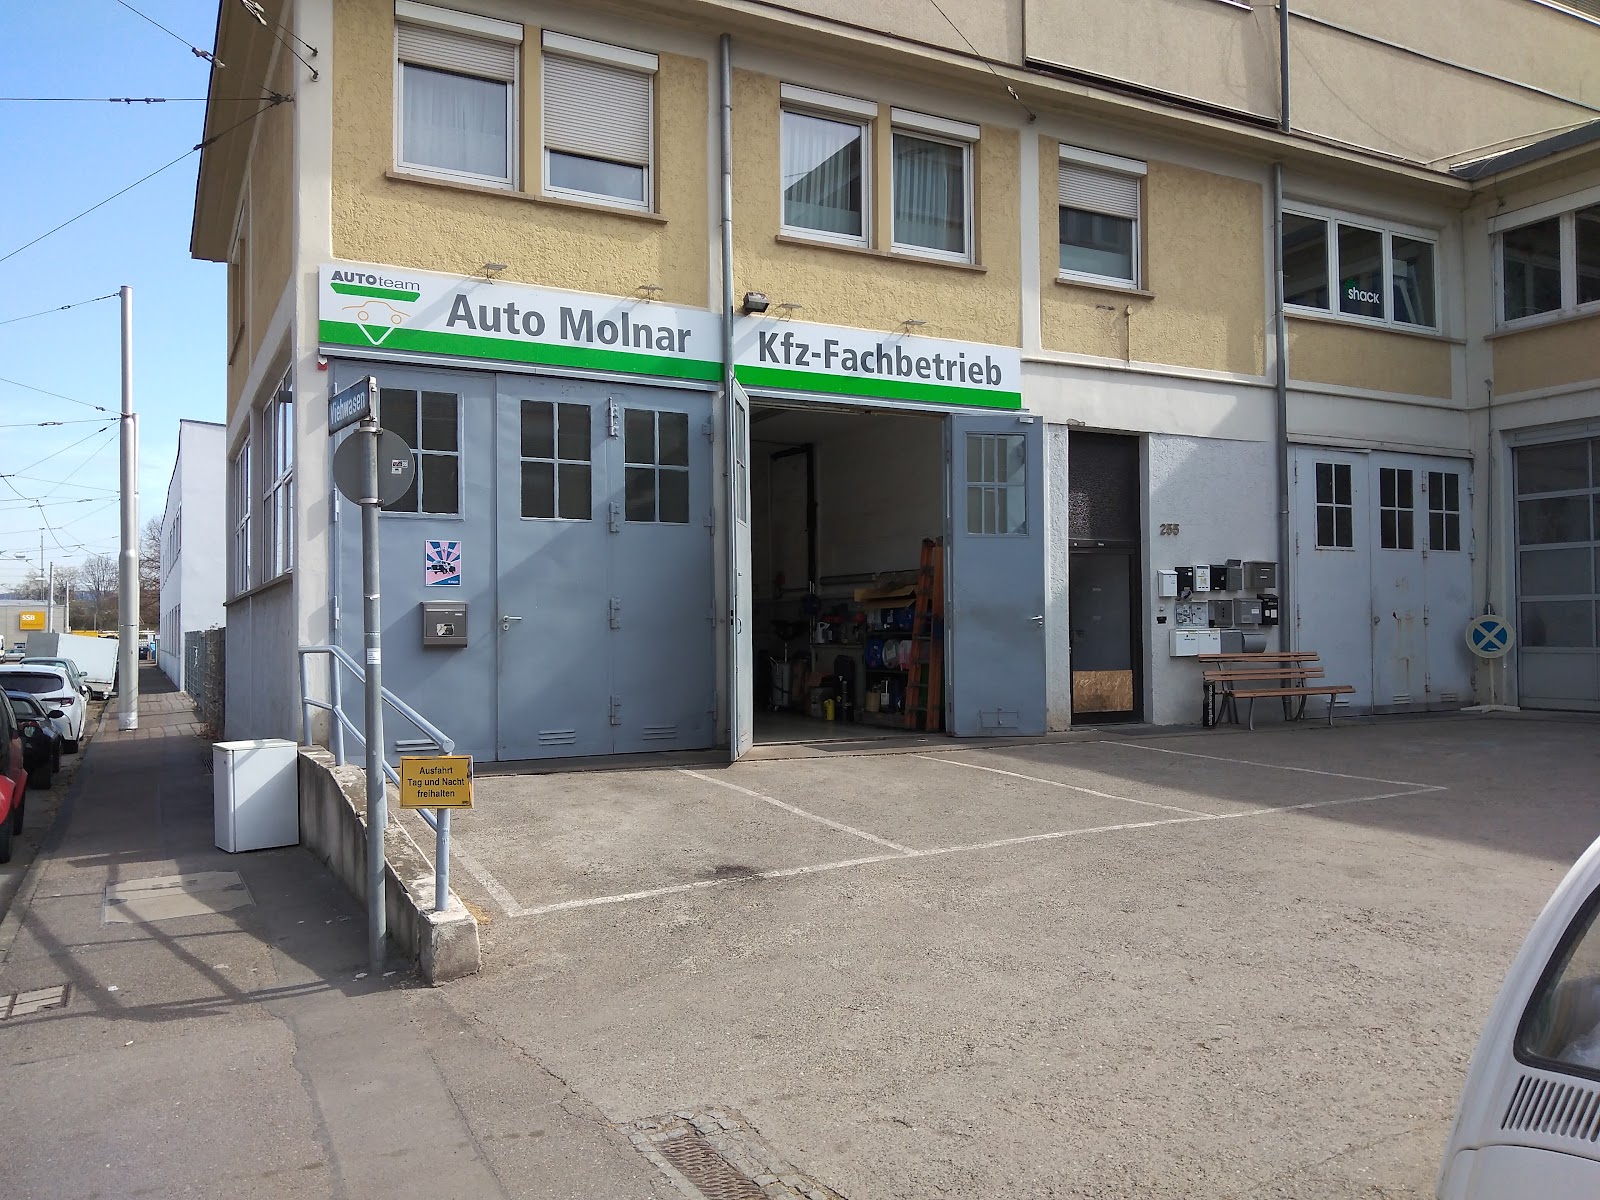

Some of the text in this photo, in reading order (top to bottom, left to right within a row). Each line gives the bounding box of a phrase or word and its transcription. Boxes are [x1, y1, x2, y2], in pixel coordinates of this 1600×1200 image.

[1348, 286, 1380, 304] shack
[446, 294, 692, 353] Auto Molnar
[758, 331, 1002, 386] Kfz-Fachbetrieb
[330, 391, 366, 425] Viehwasen
[408, 778, 422, 788] Tag
[420, 766, 452, 774] Ausfahrt
